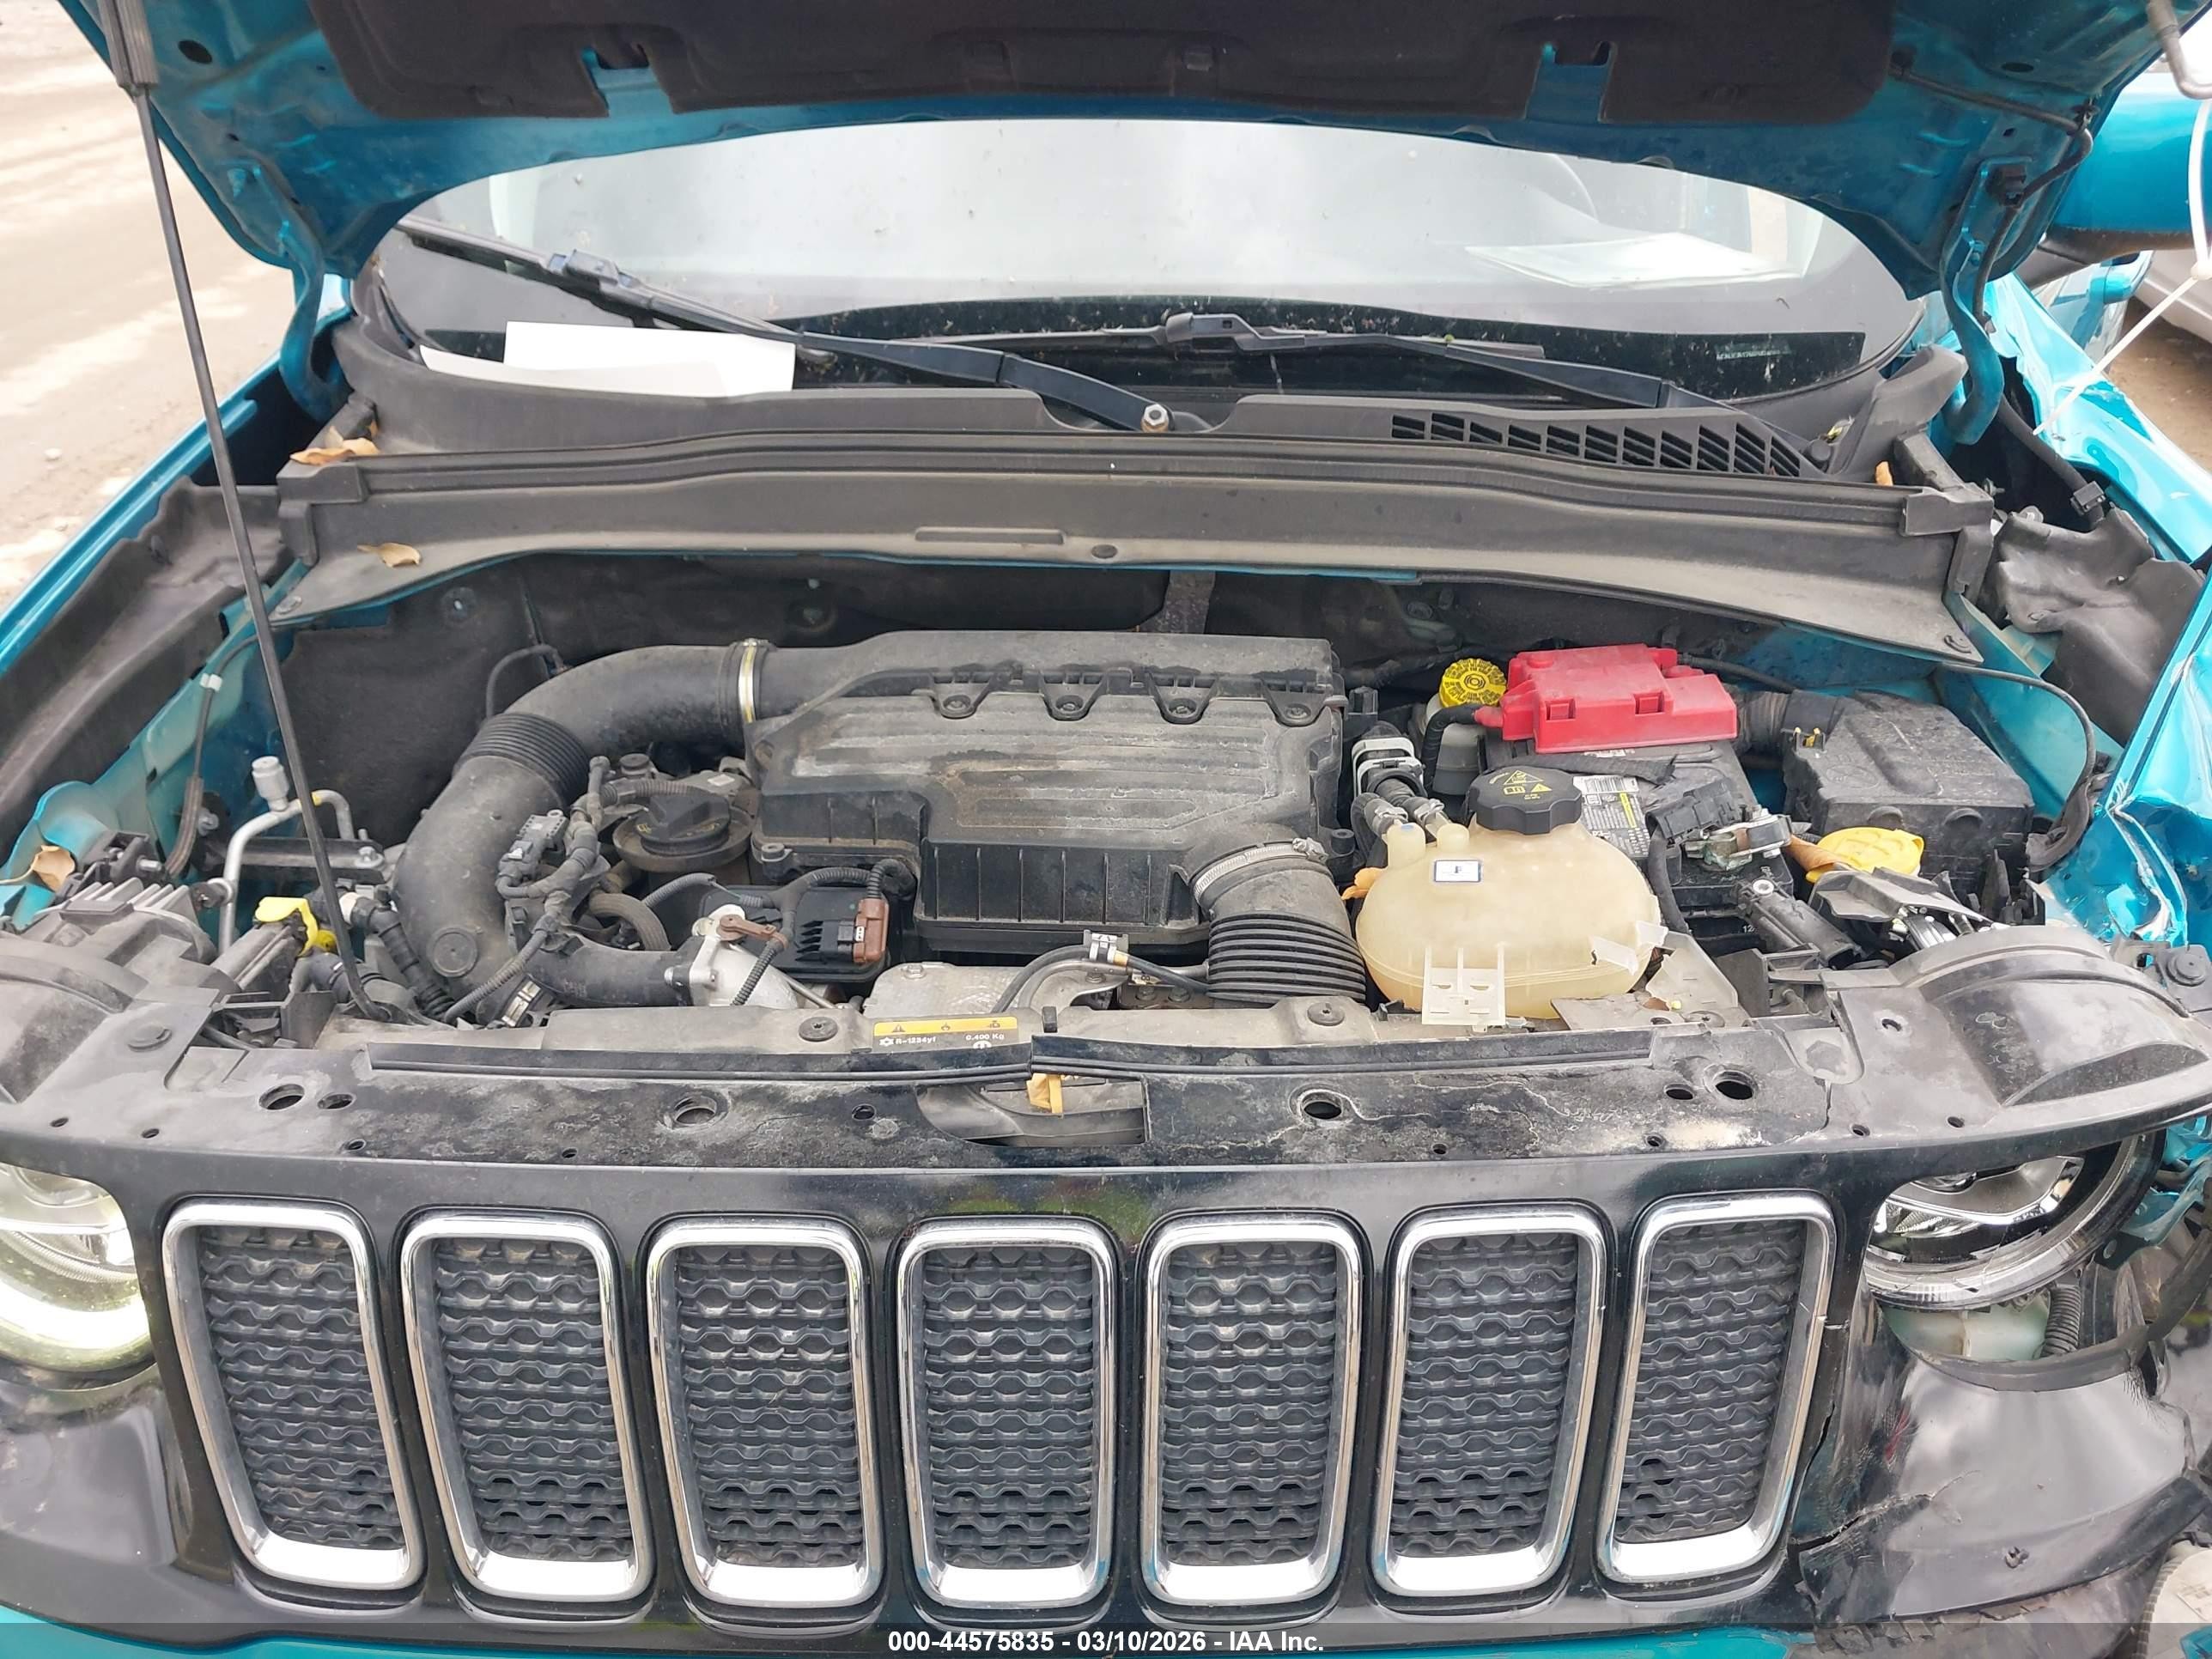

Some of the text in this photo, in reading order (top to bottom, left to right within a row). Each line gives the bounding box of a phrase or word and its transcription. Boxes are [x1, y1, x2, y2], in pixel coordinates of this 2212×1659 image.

[895, 1036, 937, 1046] R-1234yf
[965, 1033, 1005, 1042] 0.400 Kg
